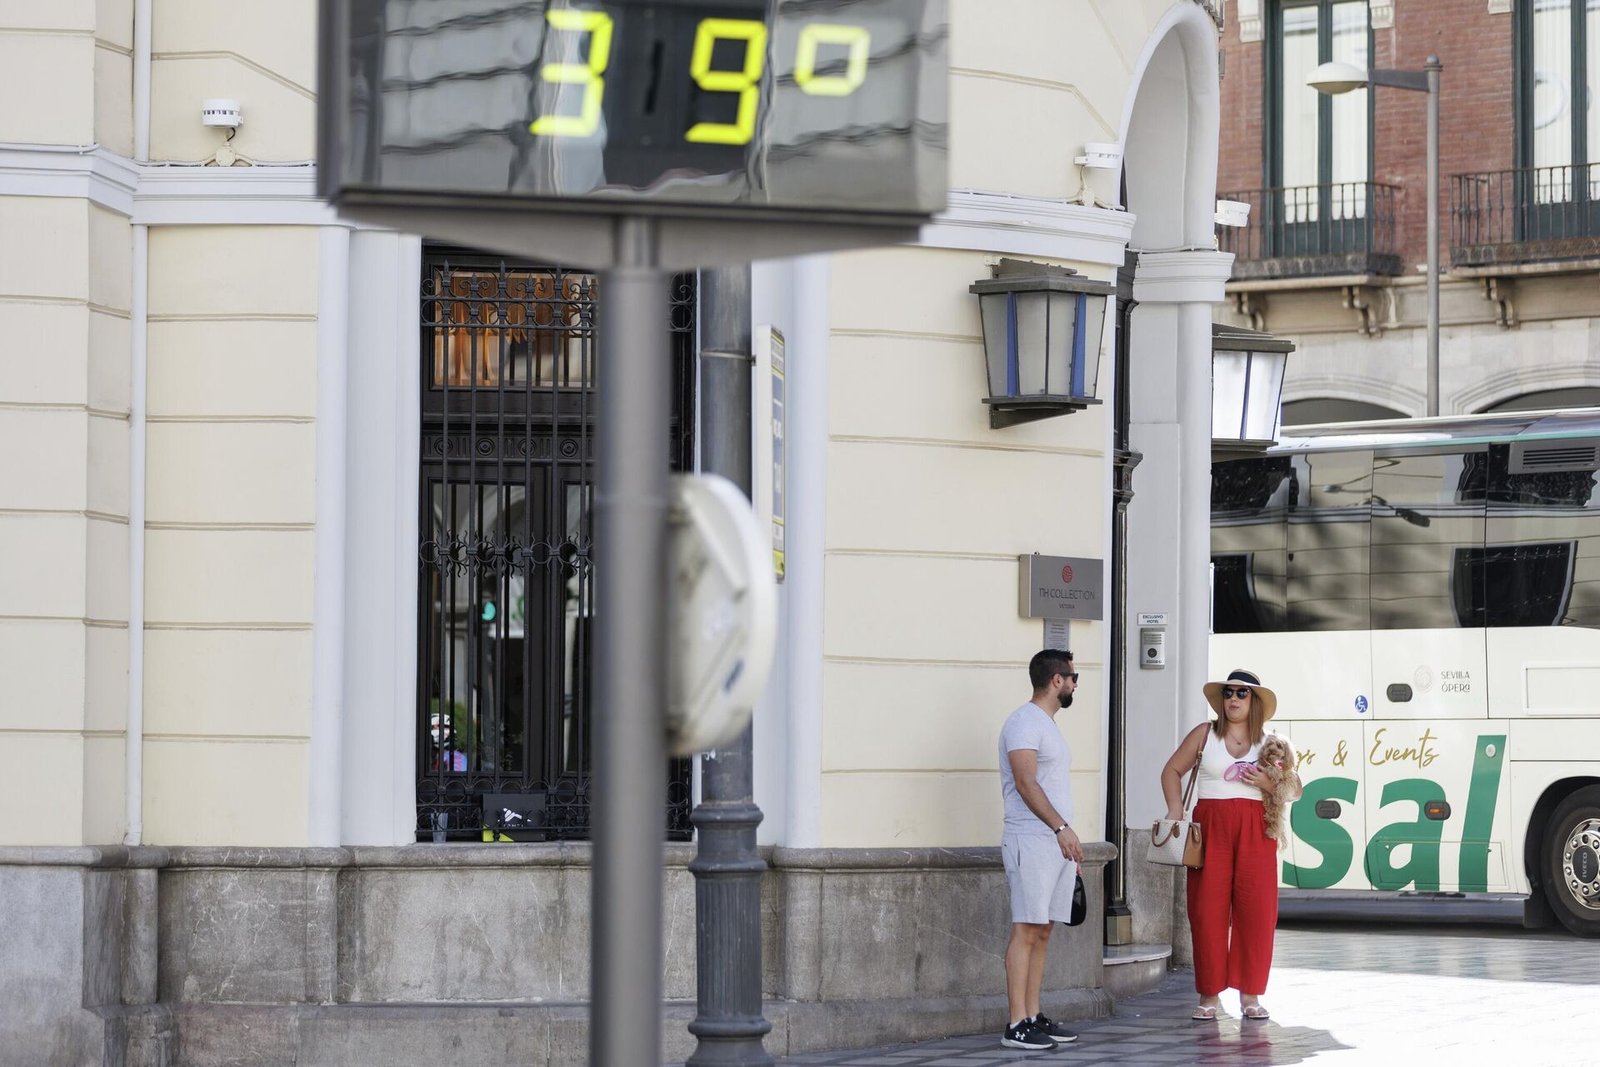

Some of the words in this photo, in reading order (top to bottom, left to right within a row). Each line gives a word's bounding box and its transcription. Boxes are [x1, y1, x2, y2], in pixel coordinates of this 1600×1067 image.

[1050, 588, 1096, 601] COLLECTION
[1332, 739, 1348, 767] &
[1369, 728, 1440, 769] Events
